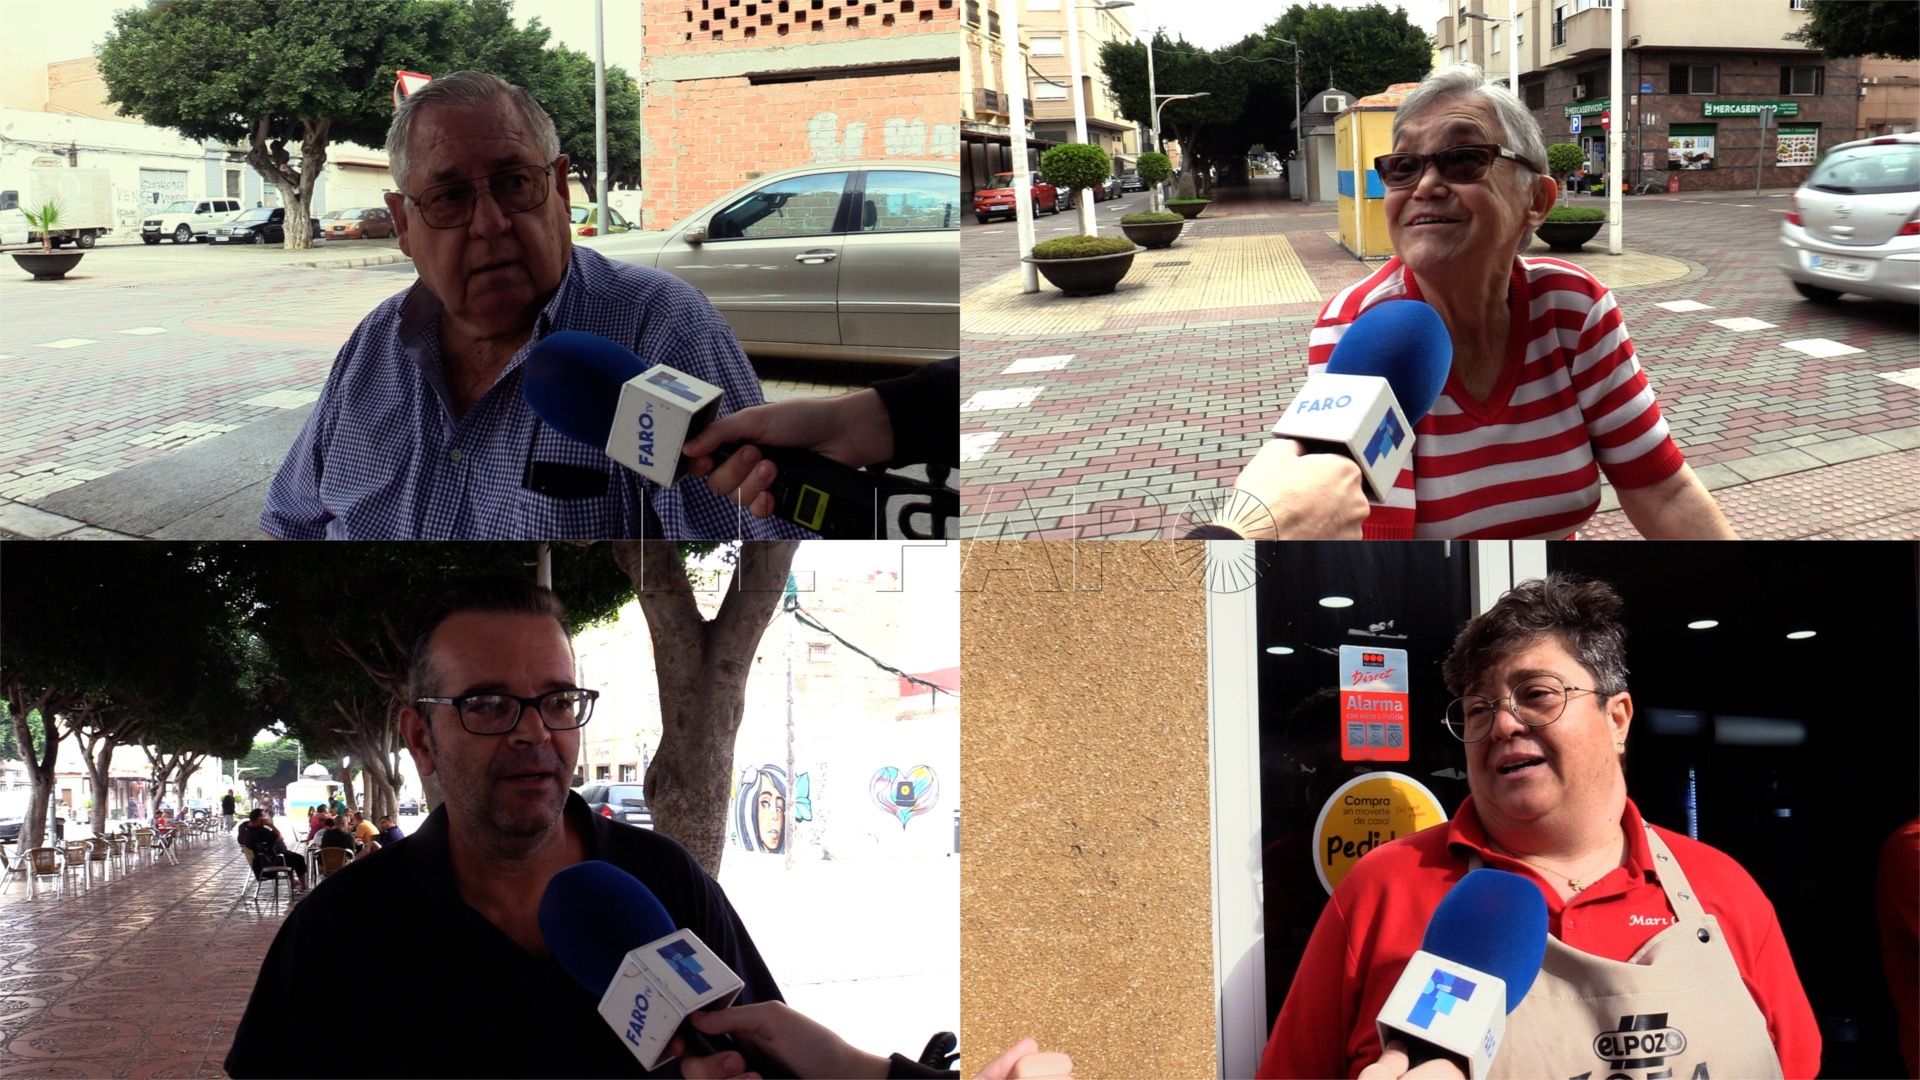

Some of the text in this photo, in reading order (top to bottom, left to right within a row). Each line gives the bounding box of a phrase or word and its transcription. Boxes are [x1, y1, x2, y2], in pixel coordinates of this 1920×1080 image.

[1296, 395, 1352, 414] FARO
[638, 413, 654, 467] FARO
[1346, 695, 1403, 711] Alarma
[1344, 795, 1390, 807] Compra
[1343, 807, 1354, 816] sin
[1355, 808, 1390, 816] moverte
[1354, 817, 1365, 825] de
[1628, 914, 1667, 927] Mari
[624, 994, 649, 1047] FARO
